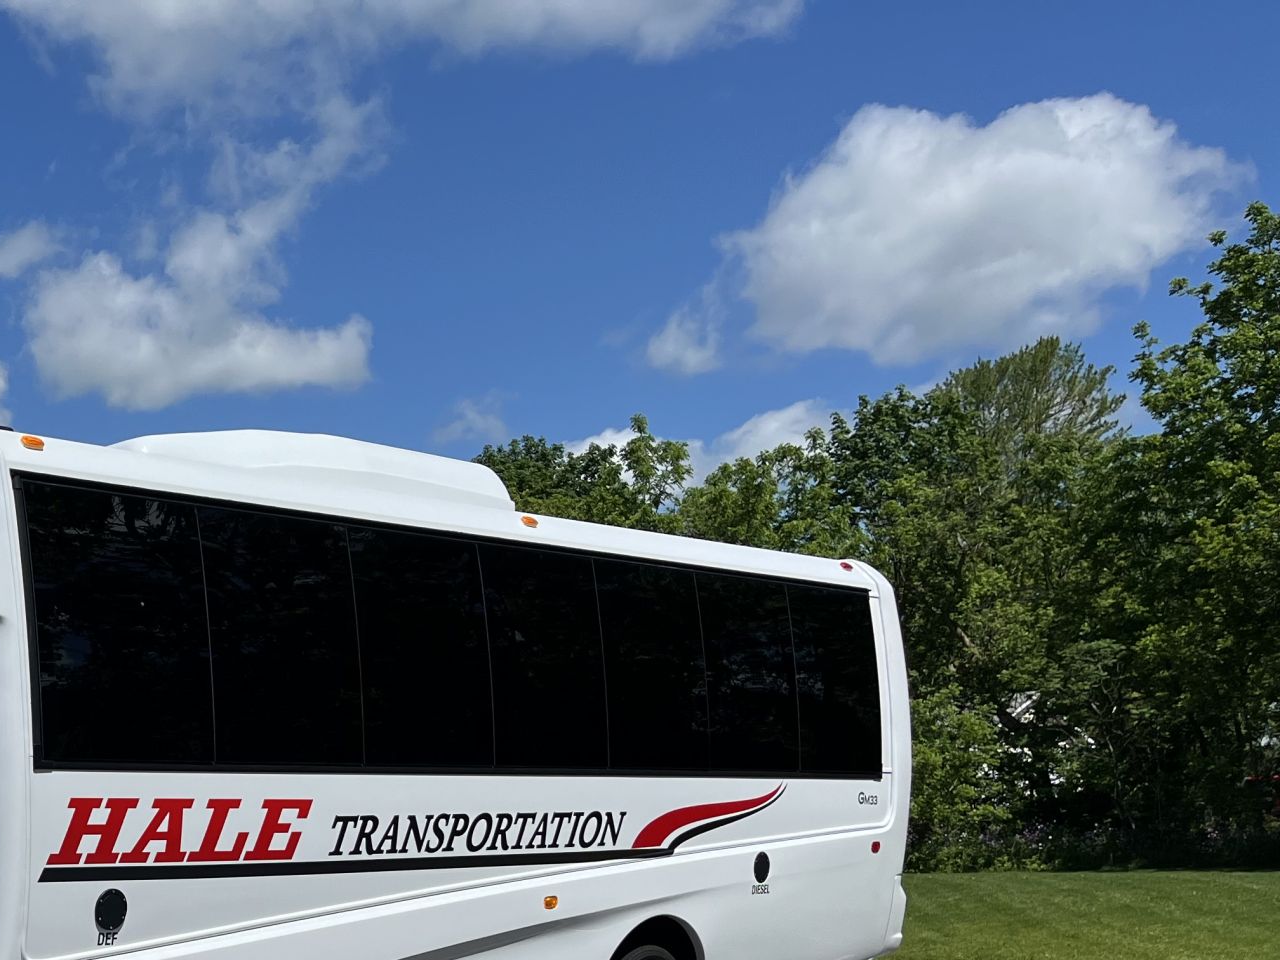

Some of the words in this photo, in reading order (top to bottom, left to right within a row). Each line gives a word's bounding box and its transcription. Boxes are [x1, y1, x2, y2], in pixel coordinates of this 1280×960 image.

[46, 797, 314, 865] HALE
[328, 811, 627, 857] TRANSPORTATION
[751, 884, 770, 895] DIESEL
[96, 931, 118, 946] DEF
